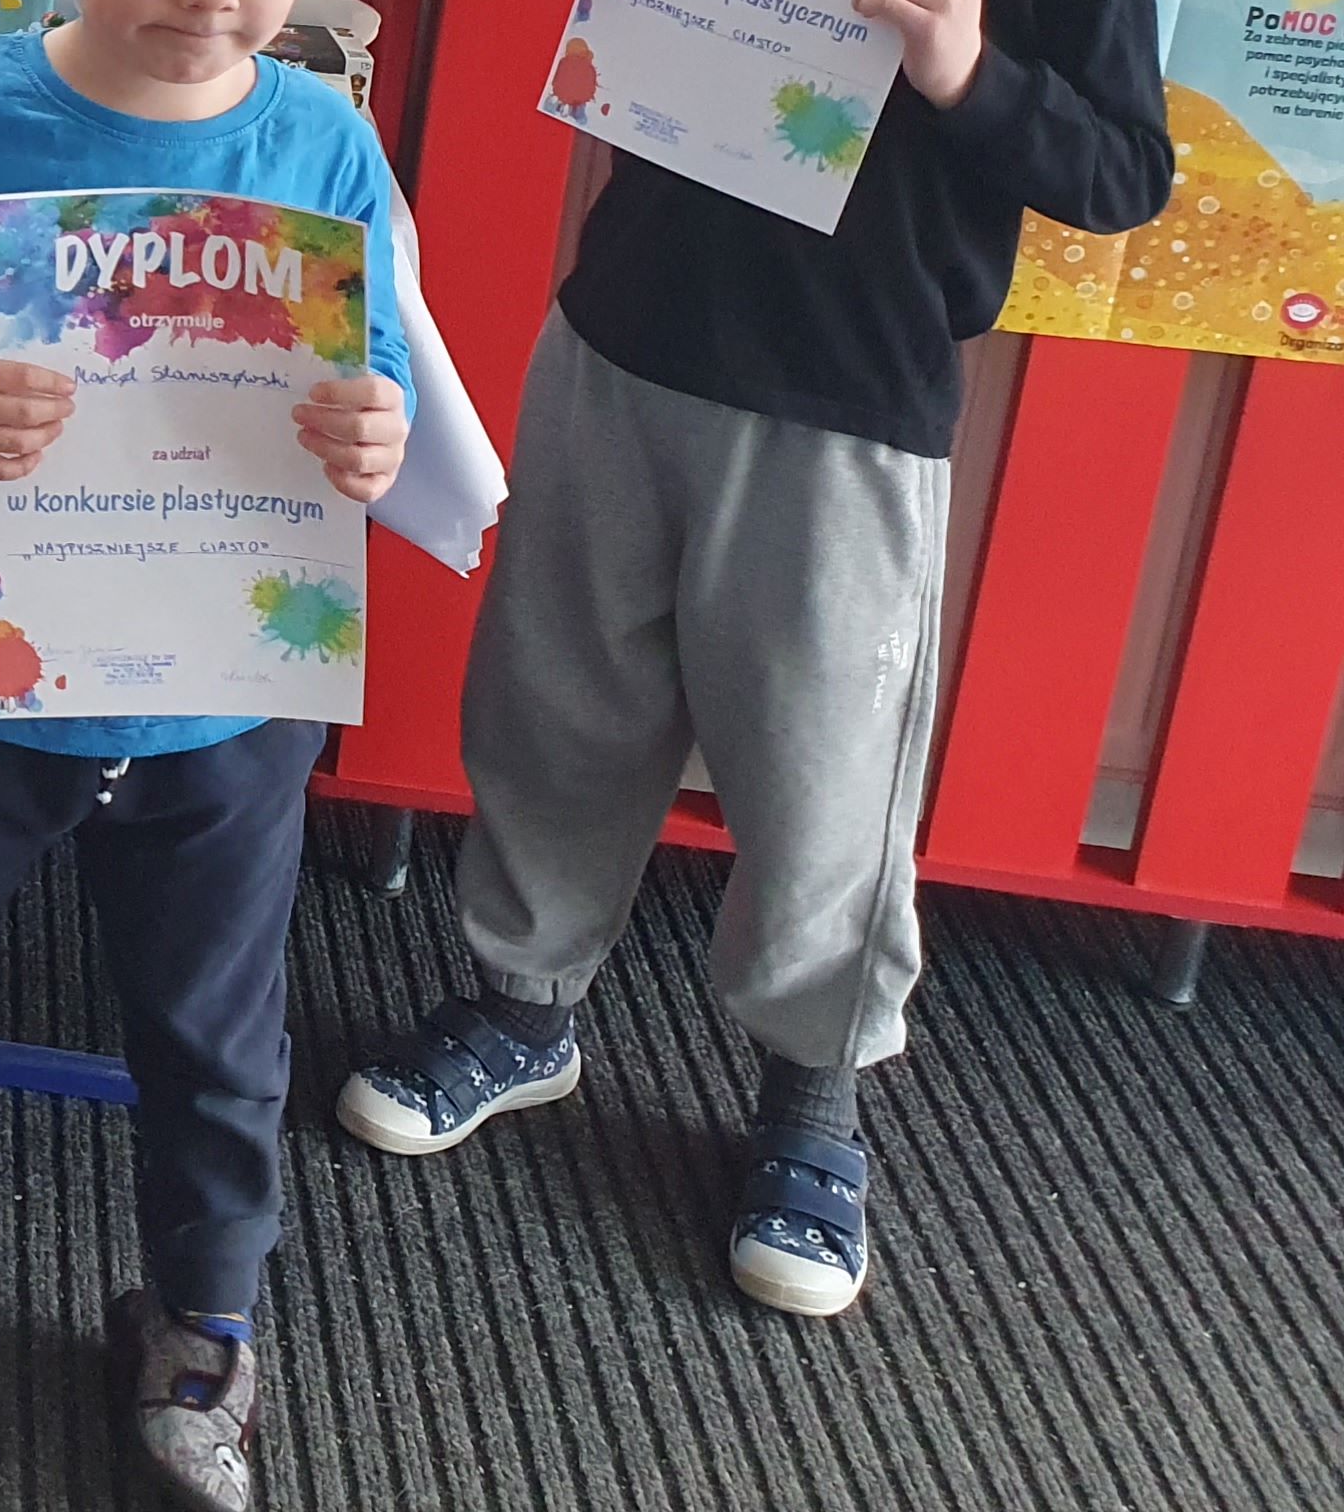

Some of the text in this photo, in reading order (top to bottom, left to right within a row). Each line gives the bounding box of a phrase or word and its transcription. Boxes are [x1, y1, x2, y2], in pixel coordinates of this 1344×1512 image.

[1245, 6, 1337, 36] PoMOC
[1243, 29, 1323, 49] Za zebrane
[1245, 50, 1293, 62] pomoc
[1273, 105, 1291, 115] na
[54, 231, 304, 304] DYPLOM
[128, 312, 225, 331] otrzymuje
[151, 445, 211, 462] za udział
[7, 484, 324, 524] w konkursie plastycznym
